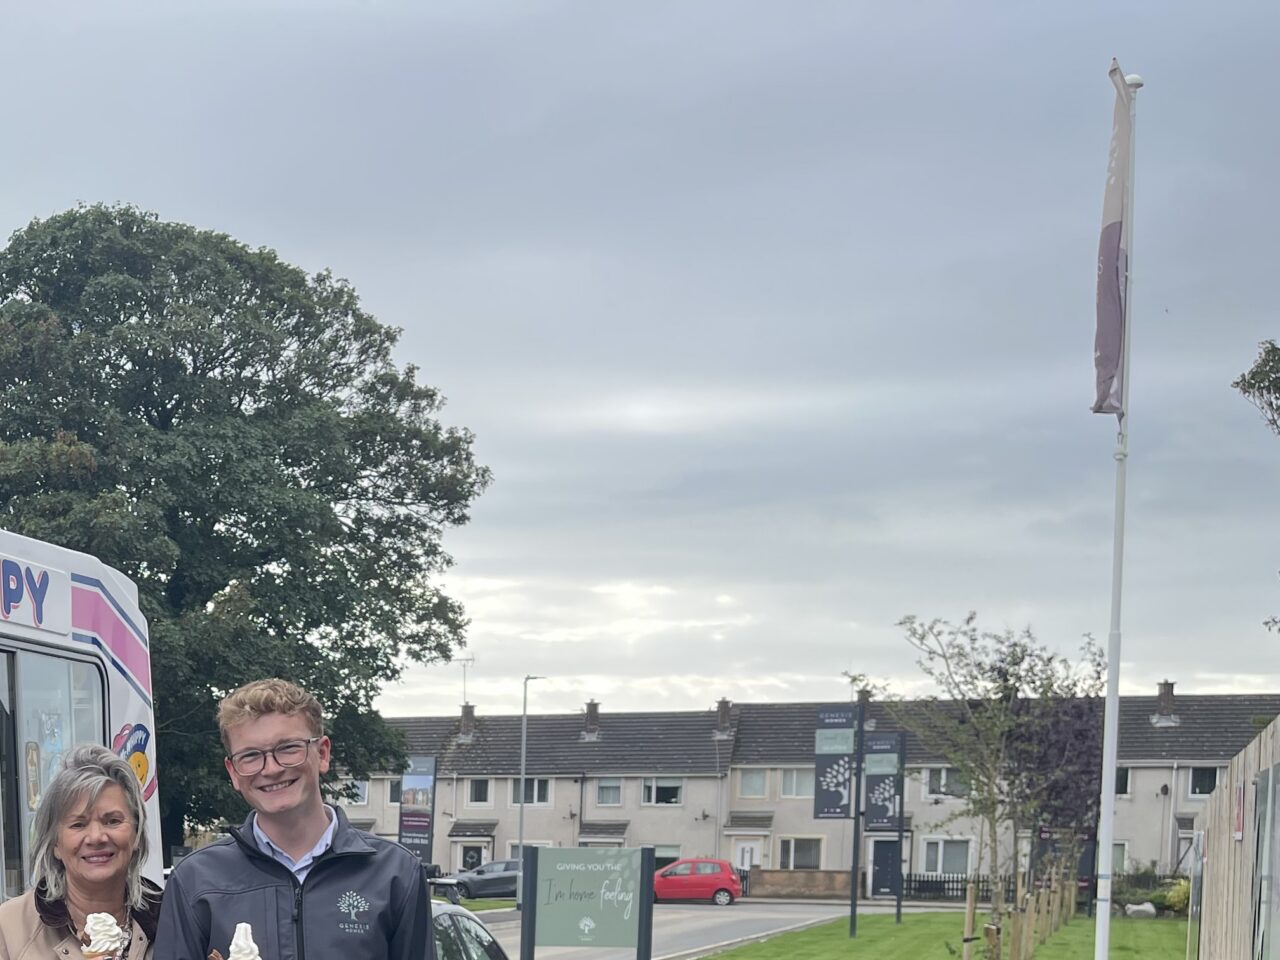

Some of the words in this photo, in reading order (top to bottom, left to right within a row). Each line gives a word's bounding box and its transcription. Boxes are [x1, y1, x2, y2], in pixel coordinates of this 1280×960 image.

[556, 863, 586, 871] GIVING
[587, 863, 605, 871] YOU
[605, 863, 622, 871] THE
[600, 877, 634, 920] feeling
